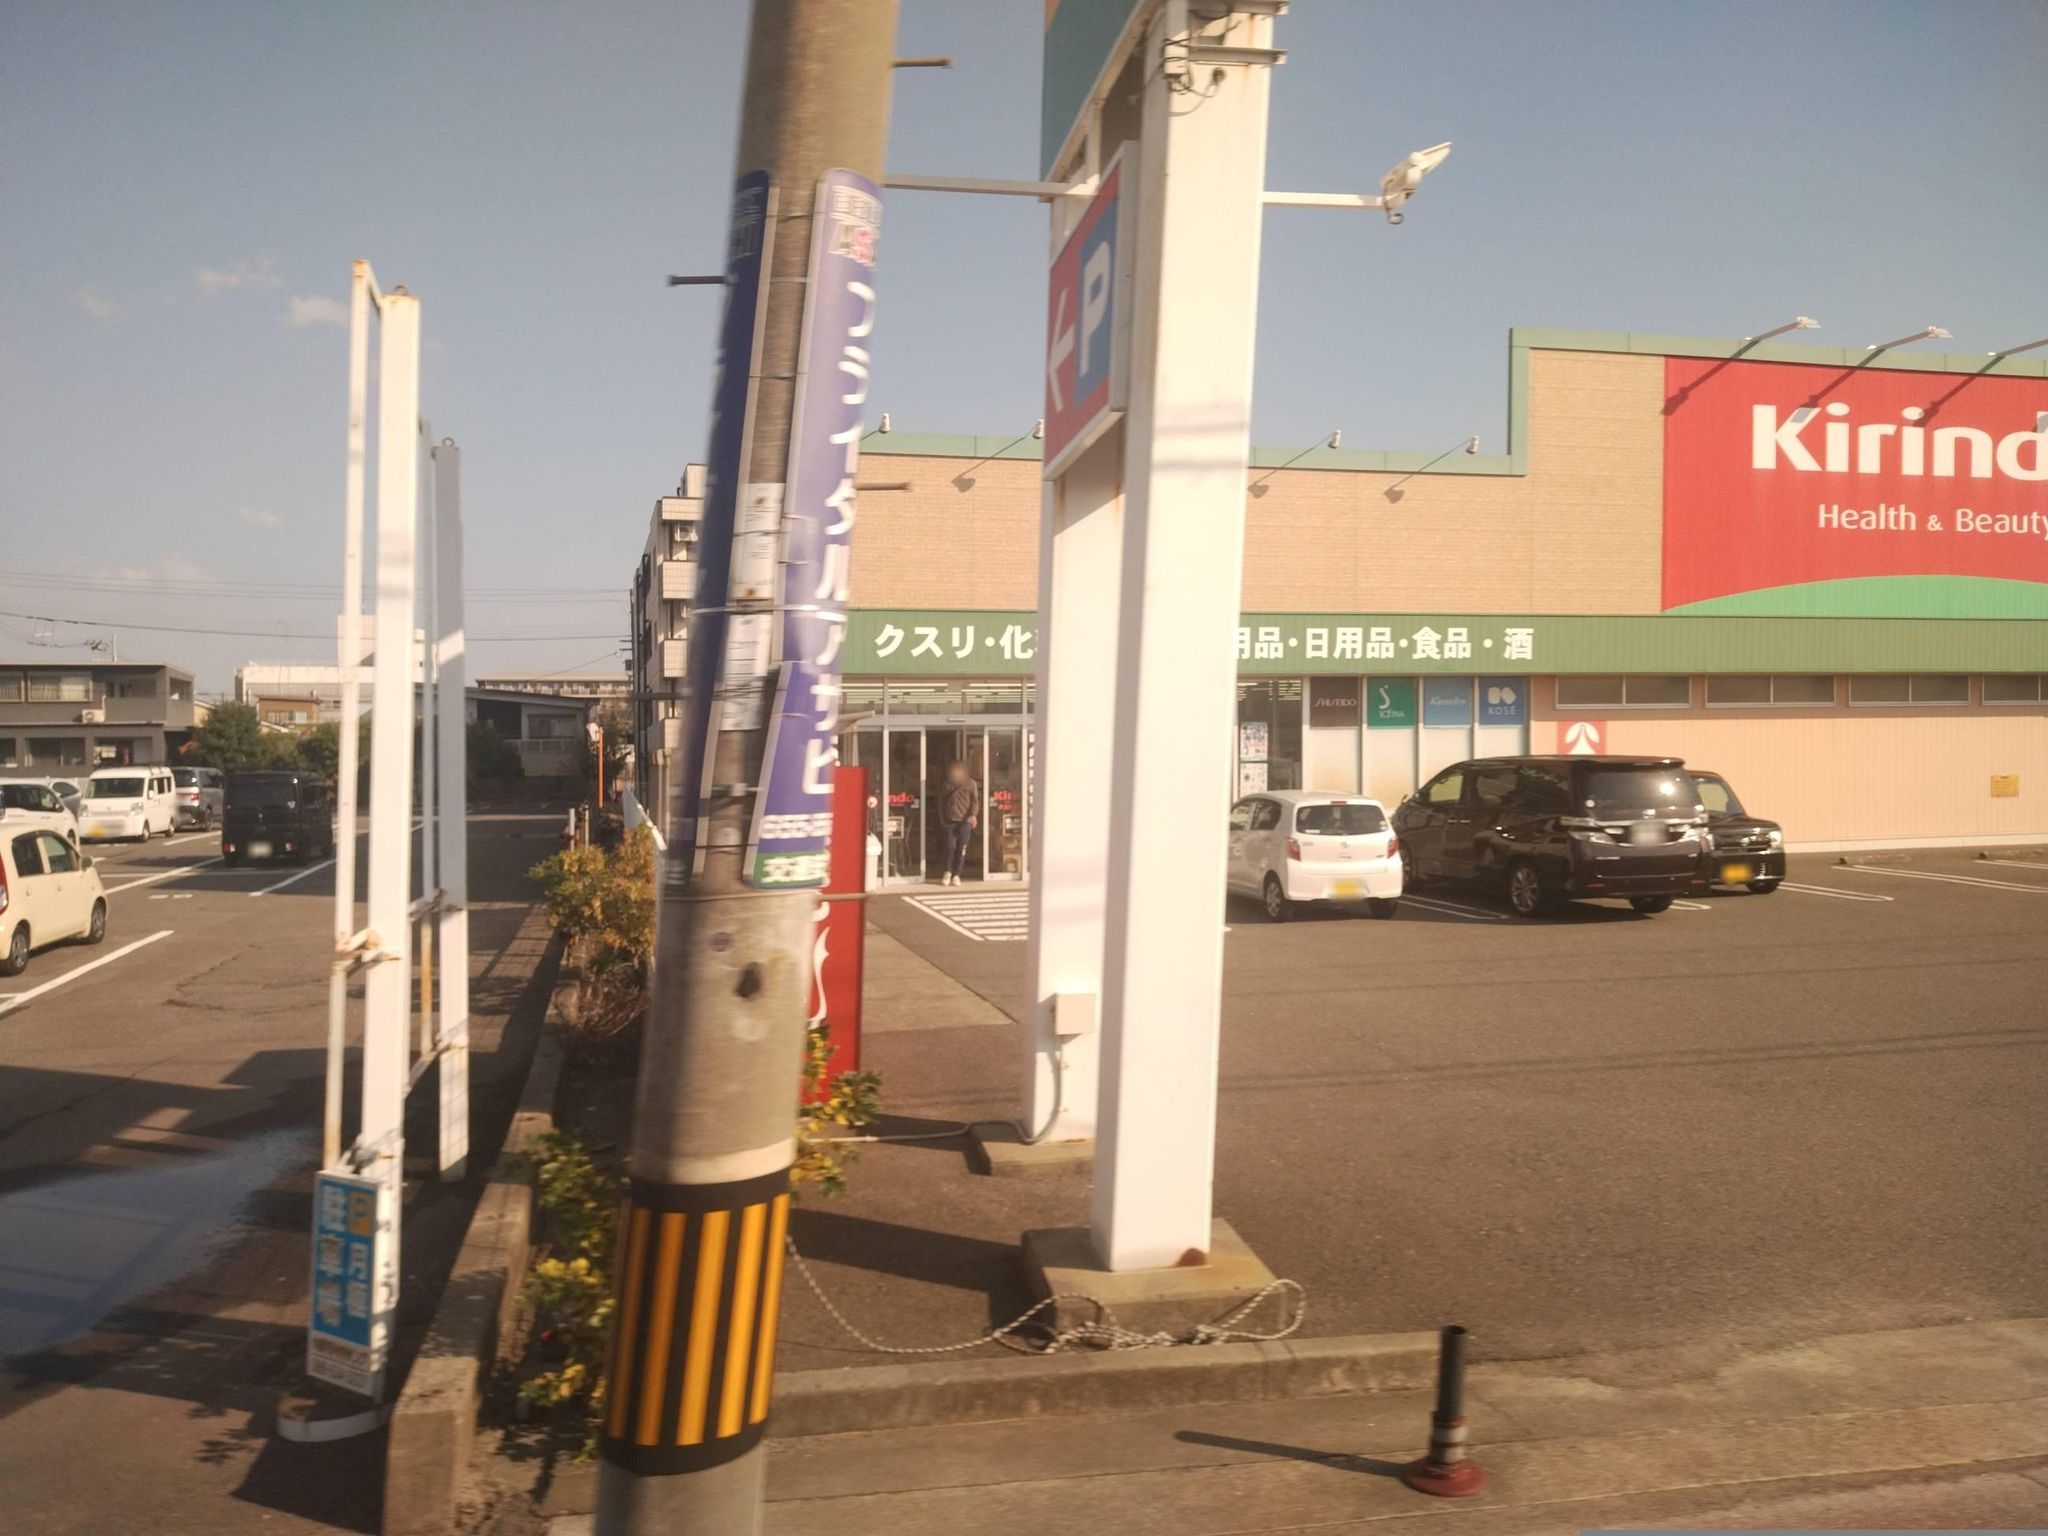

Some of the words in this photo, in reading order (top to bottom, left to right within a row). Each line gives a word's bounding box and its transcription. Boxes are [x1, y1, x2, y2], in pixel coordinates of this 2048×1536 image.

[1081, 241, 1111, 378] P
[1752, 401, 2048, 481] Kirind
[1818, 503, 1916, 532] Health
[1927, 513, 1943, 531] &
[1955, 507, 2048, 541] Beauty
[875, 624, 1038, 660] クスリ・化
[1313, 698, 1357, 708] SHISEIDO
